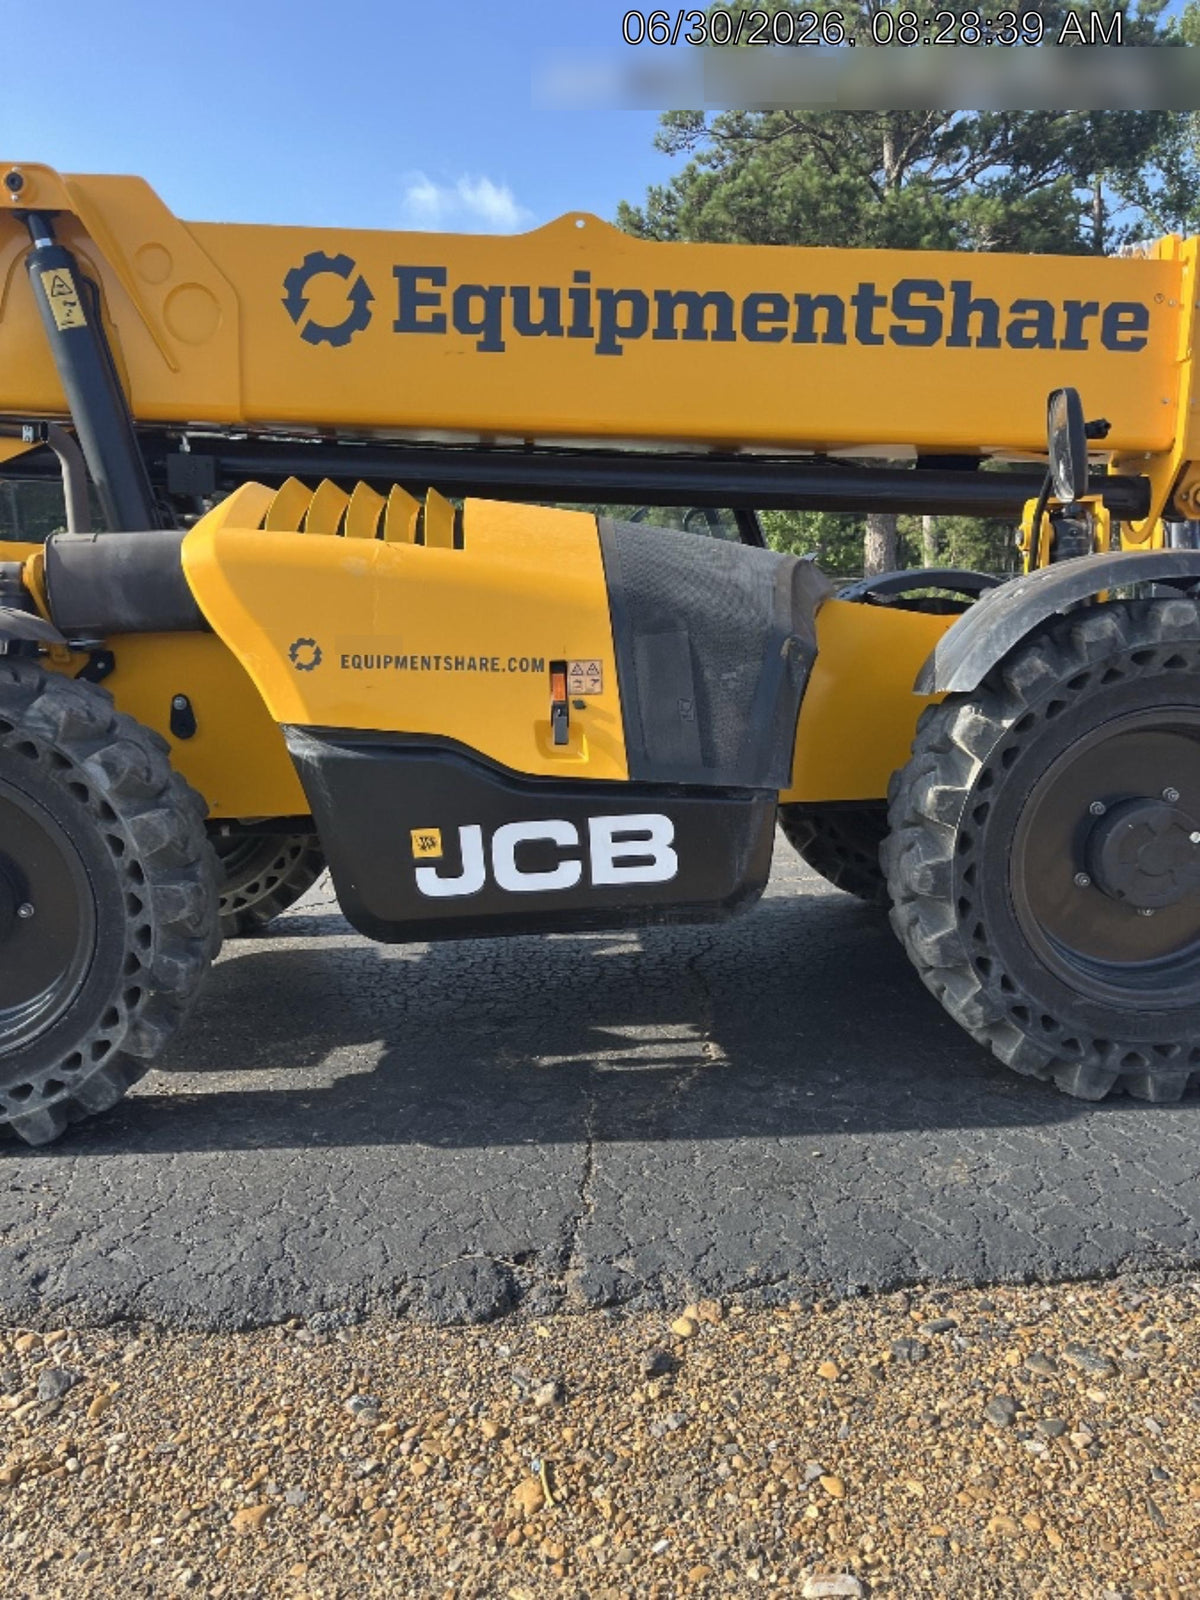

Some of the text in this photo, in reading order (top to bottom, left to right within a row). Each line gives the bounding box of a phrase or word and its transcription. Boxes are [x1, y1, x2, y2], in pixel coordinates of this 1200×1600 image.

[393, 265, 1149, 355] EquipmentShare
[341, 654, 545, 673] EQUIPMENTSHARE.COM
[414, 813, 679, 898] JCB
